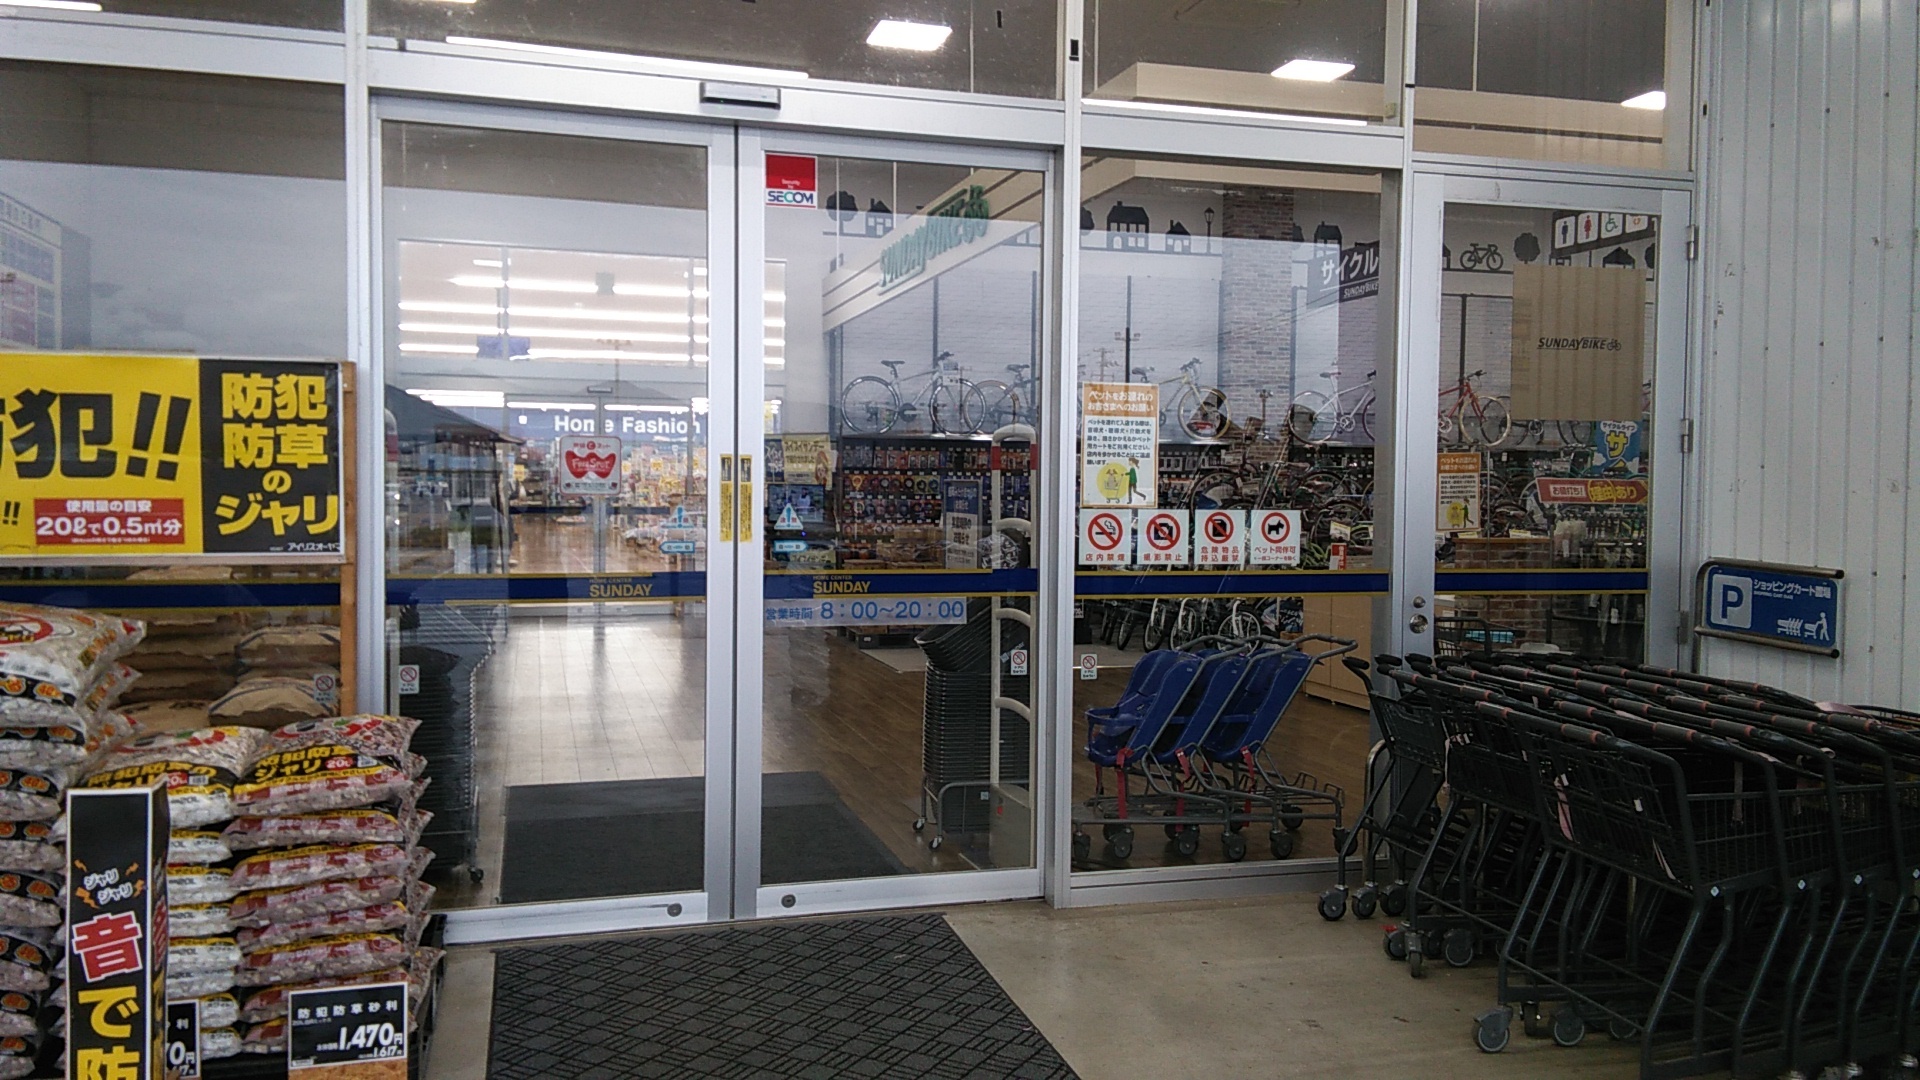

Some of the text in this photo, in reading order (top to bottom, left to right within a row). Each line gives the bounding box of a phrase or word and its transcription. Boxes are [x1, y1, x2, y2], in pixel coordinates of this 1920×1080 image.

[768, 190, 813, 205] SECOM
[1321, 247, 1379, 285] サイクル
[1538, 337, 1608, 351] SUNDAYBIKE
[221, 373, 328, 420] 防犯
[0, 387, 192, 482] 犯!!
[223, 423, 329, 469] 防草
[262, 470, 292, 494] の
[66, 500, 152, 514] 使用量の目安
[215, 493, 338, 536] ジャリ
[1085, 553, 1125, 562] 店内禁煙
[1143, 553, 1182, 562] 撮影禁止
[1201, 546, 1240, 554] 危険物品
[1201, 554, 1240, 562] 持込厳禁
[1254, 546, 1296, 554] ペット同伴可
[589, 584, 653, 597] SUNDAY
[813, 581, 871, 594] SUNDAY
[1721, 584, 1744, 620] P
[765, 607, 813, 621] 営業時間
[254, 759, 321, 784] ジャリ
[84, 868, 120, 891] ジャリ
[97, 882, 134, 905] ジャリ
[297, 1000, 398, 1020] 防犯防草砂利
